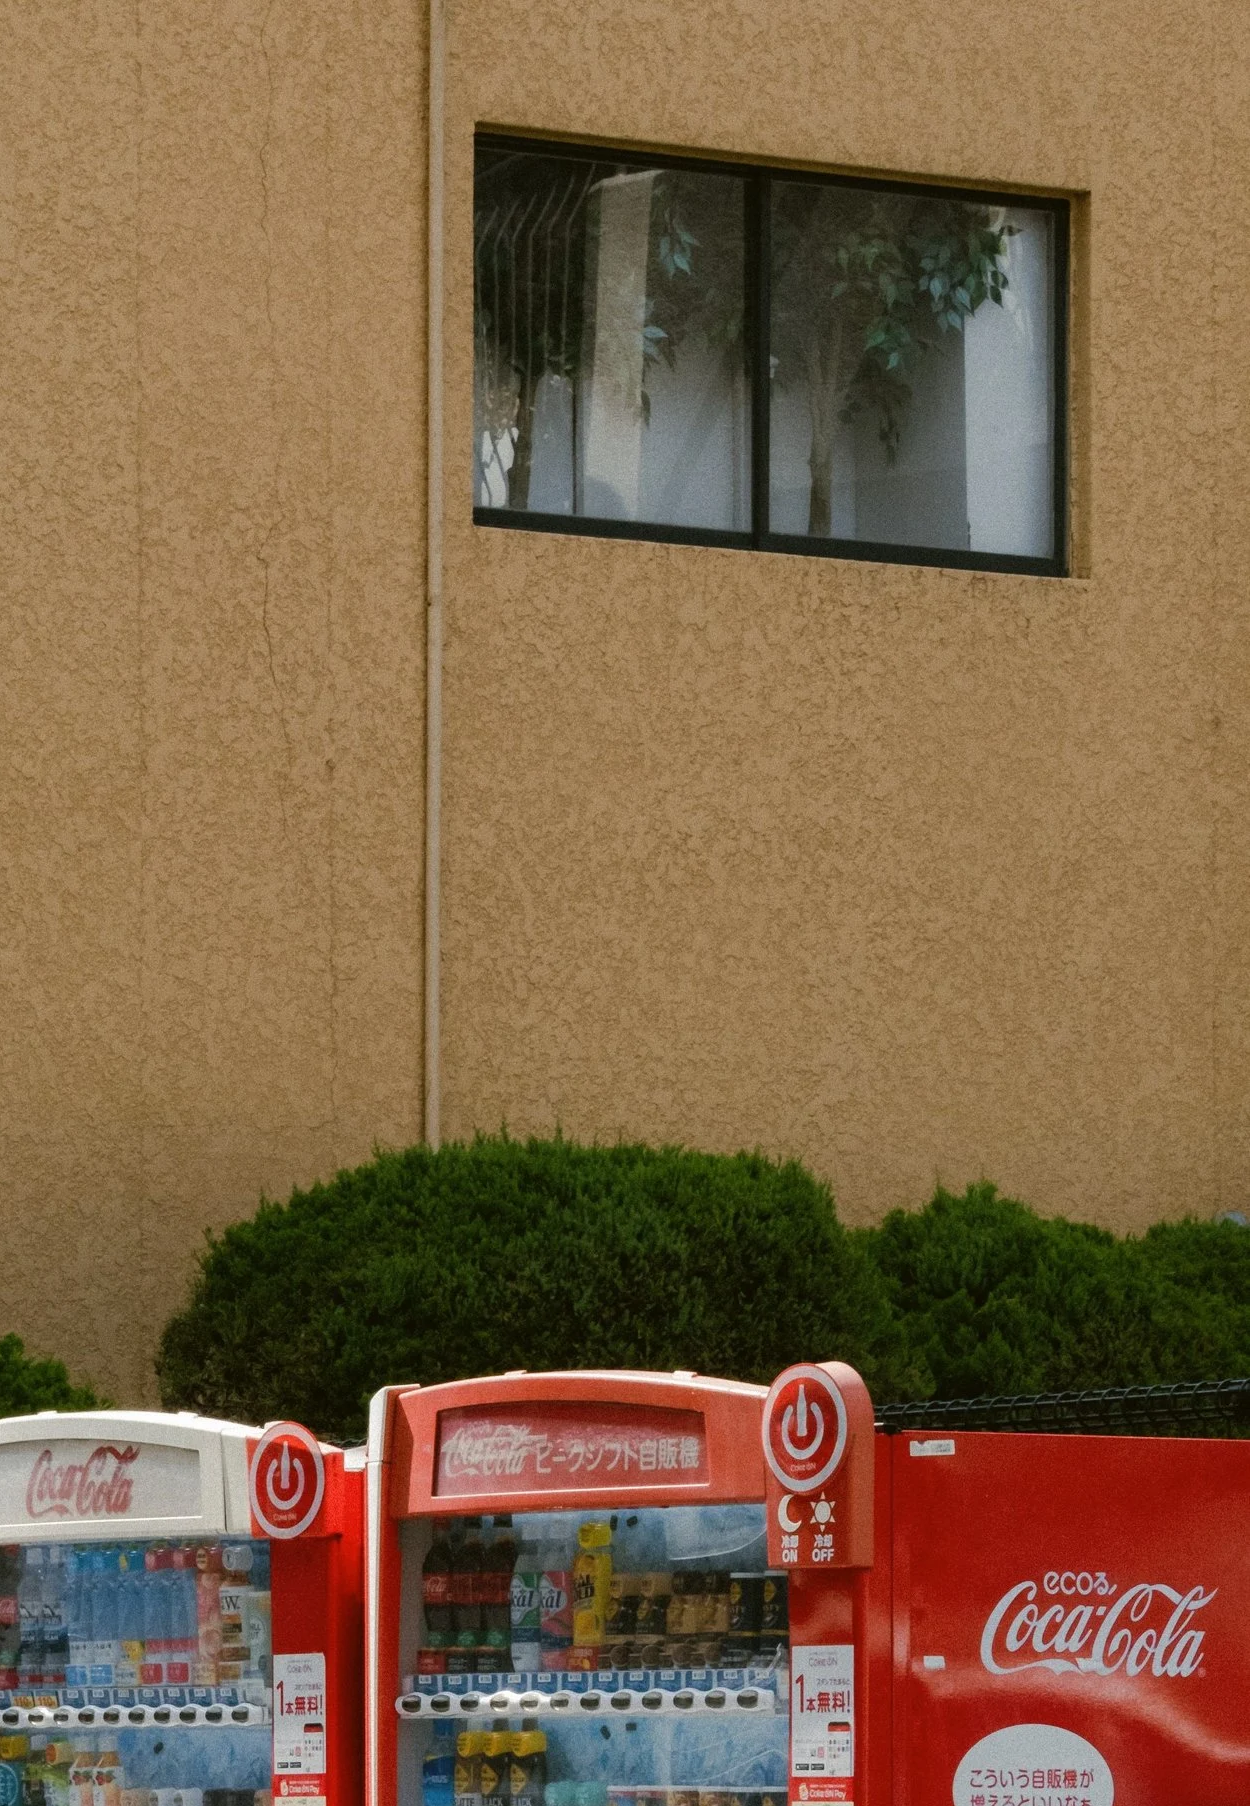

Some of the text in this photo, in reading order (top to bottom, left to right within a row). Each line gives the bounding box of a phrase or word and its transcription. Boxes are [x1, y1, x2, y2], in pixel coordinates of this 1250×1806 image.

[535, 1437, 700, 1474] ピークシフト自販機
[782, 1549, 798, 1563] ON
[812, 1548, 835, 1562] OFF
[980, 1580, 1219, 1679] Coca-Cola
[276, 1680, 323, 1717] 1本無料!
[795, 1674, 851, 1713] 1本無料!
[969, 1768, 1095, 1789] こういう自販機が
